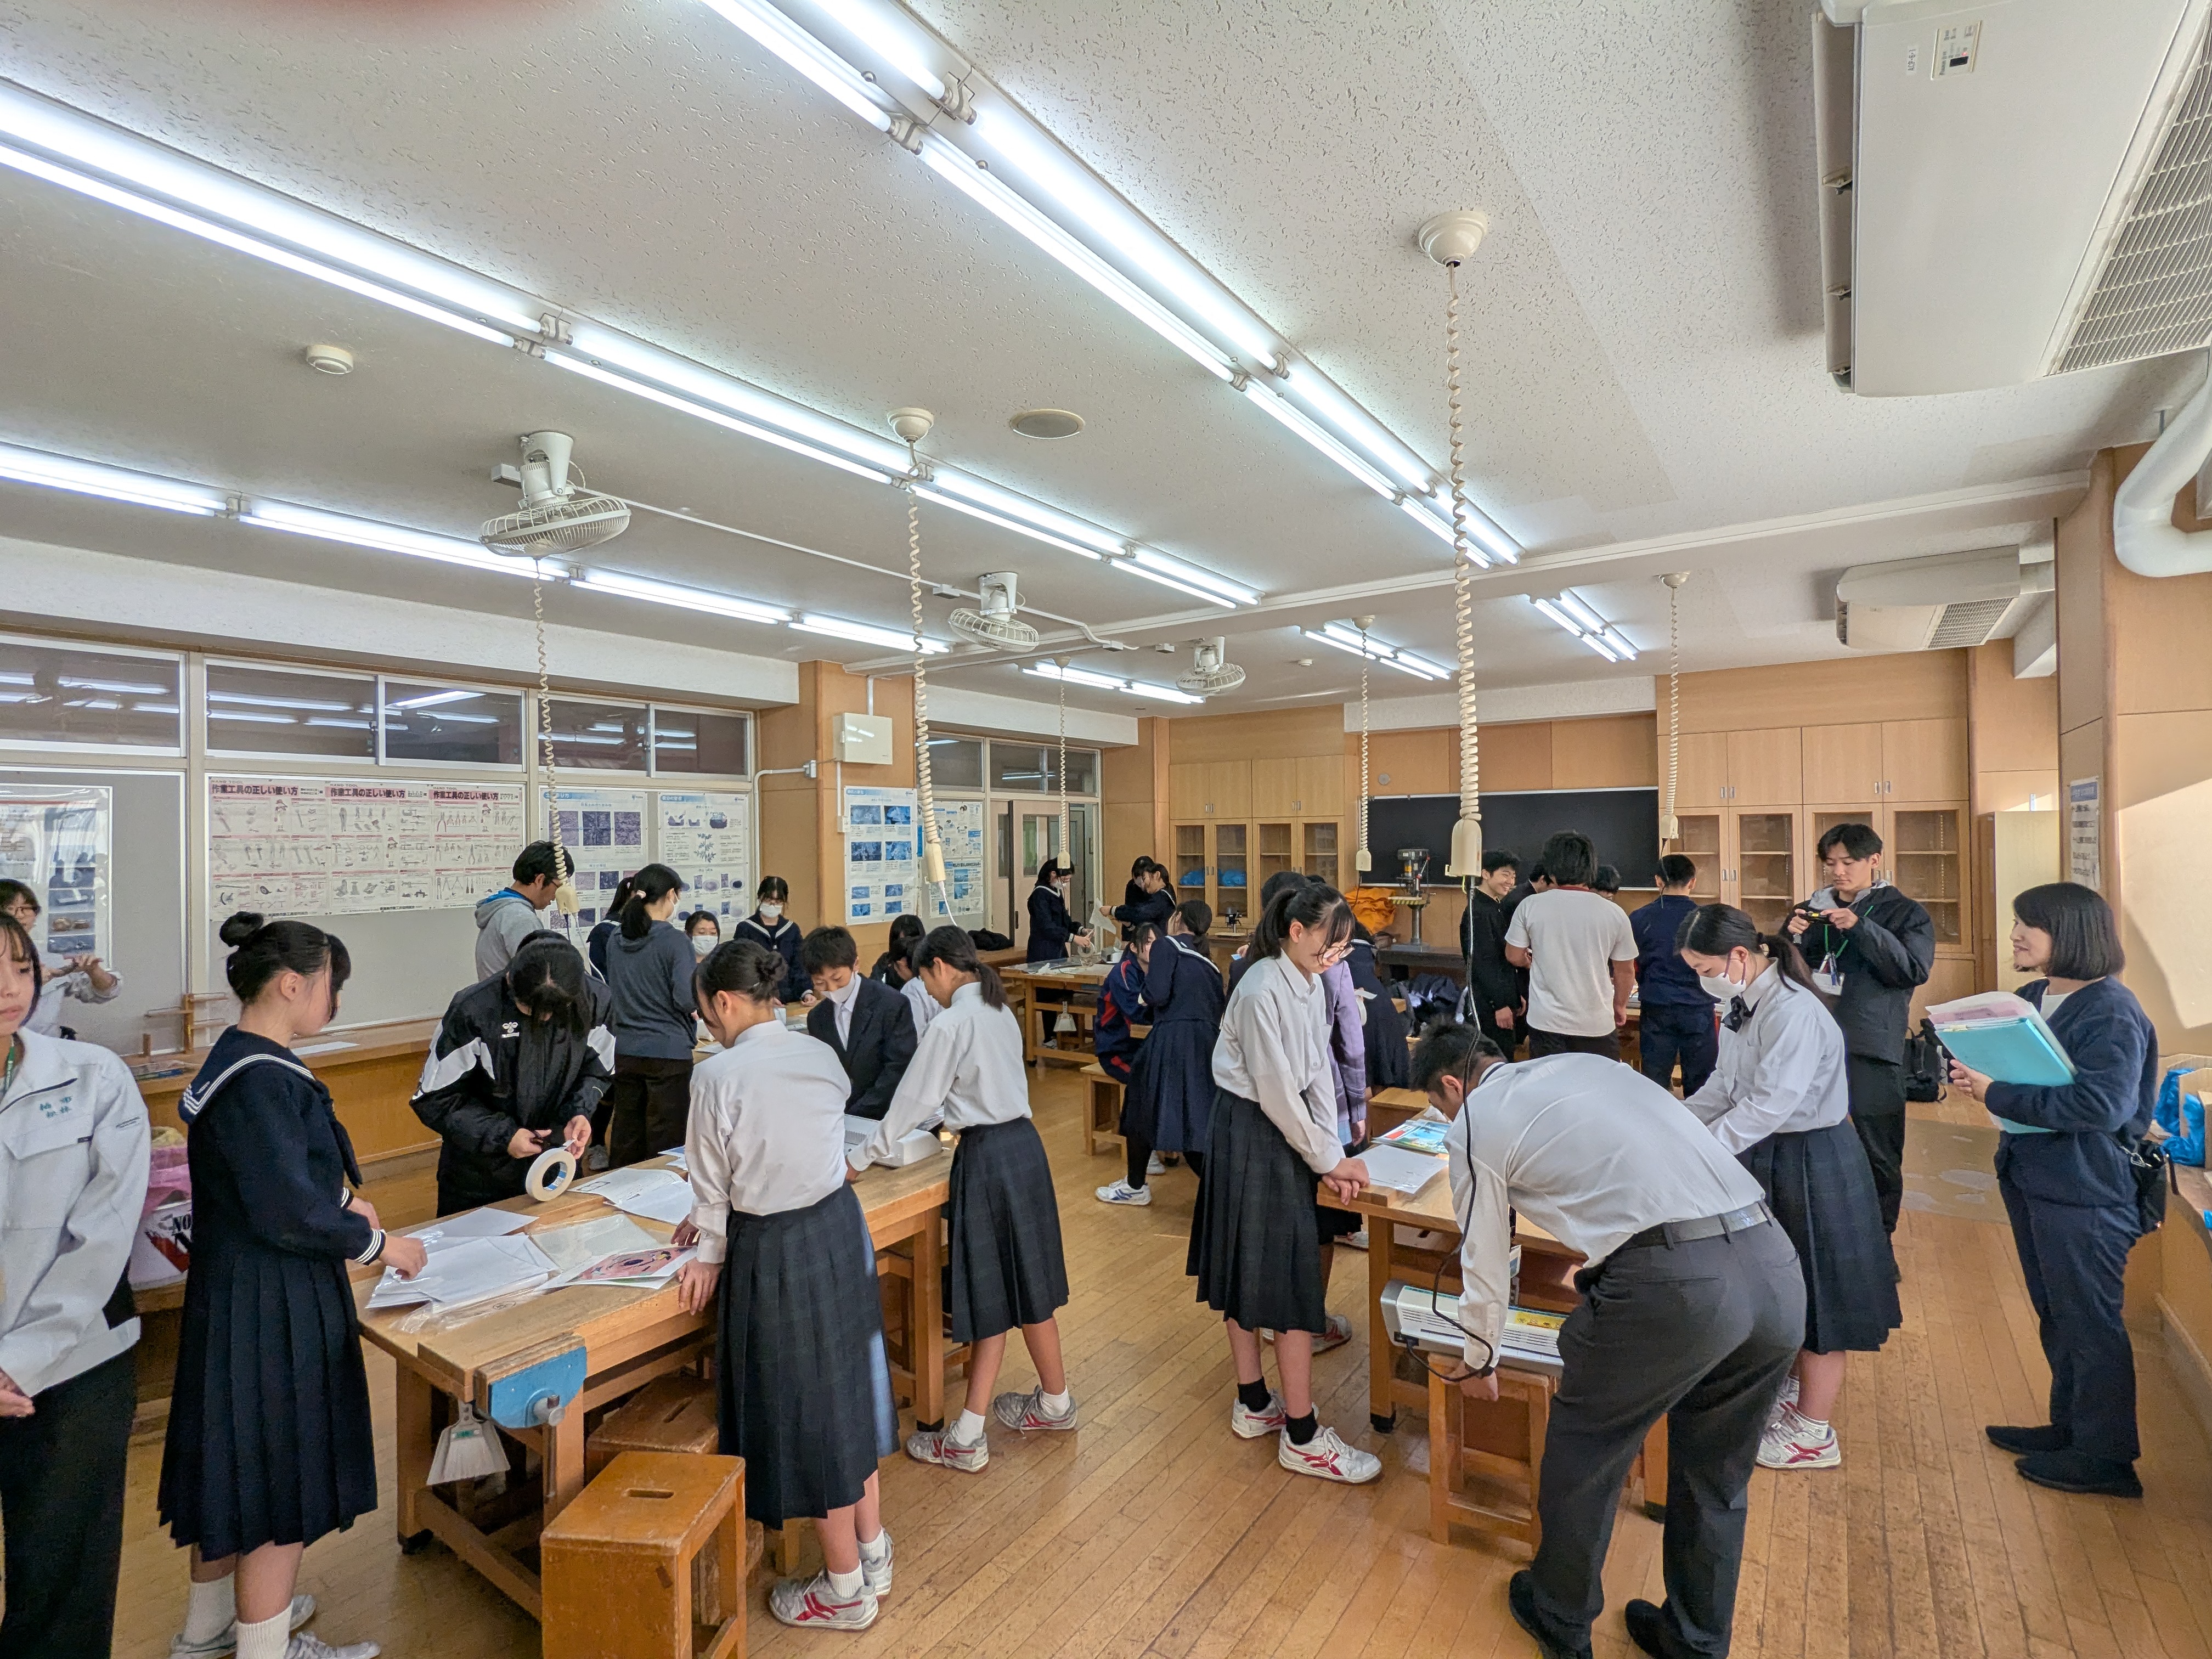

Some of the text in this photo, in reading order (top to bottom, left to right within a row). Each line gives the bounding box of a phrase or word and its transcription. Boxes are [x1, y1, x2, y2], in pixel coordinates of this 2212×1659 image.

[212, 784, 298, 795] 作業工具の正しい使い方
[331, 788, 406, 798] 作業工具の正しい使い方
[433, 791, 499, 800] 作業工具の正しい使い方
